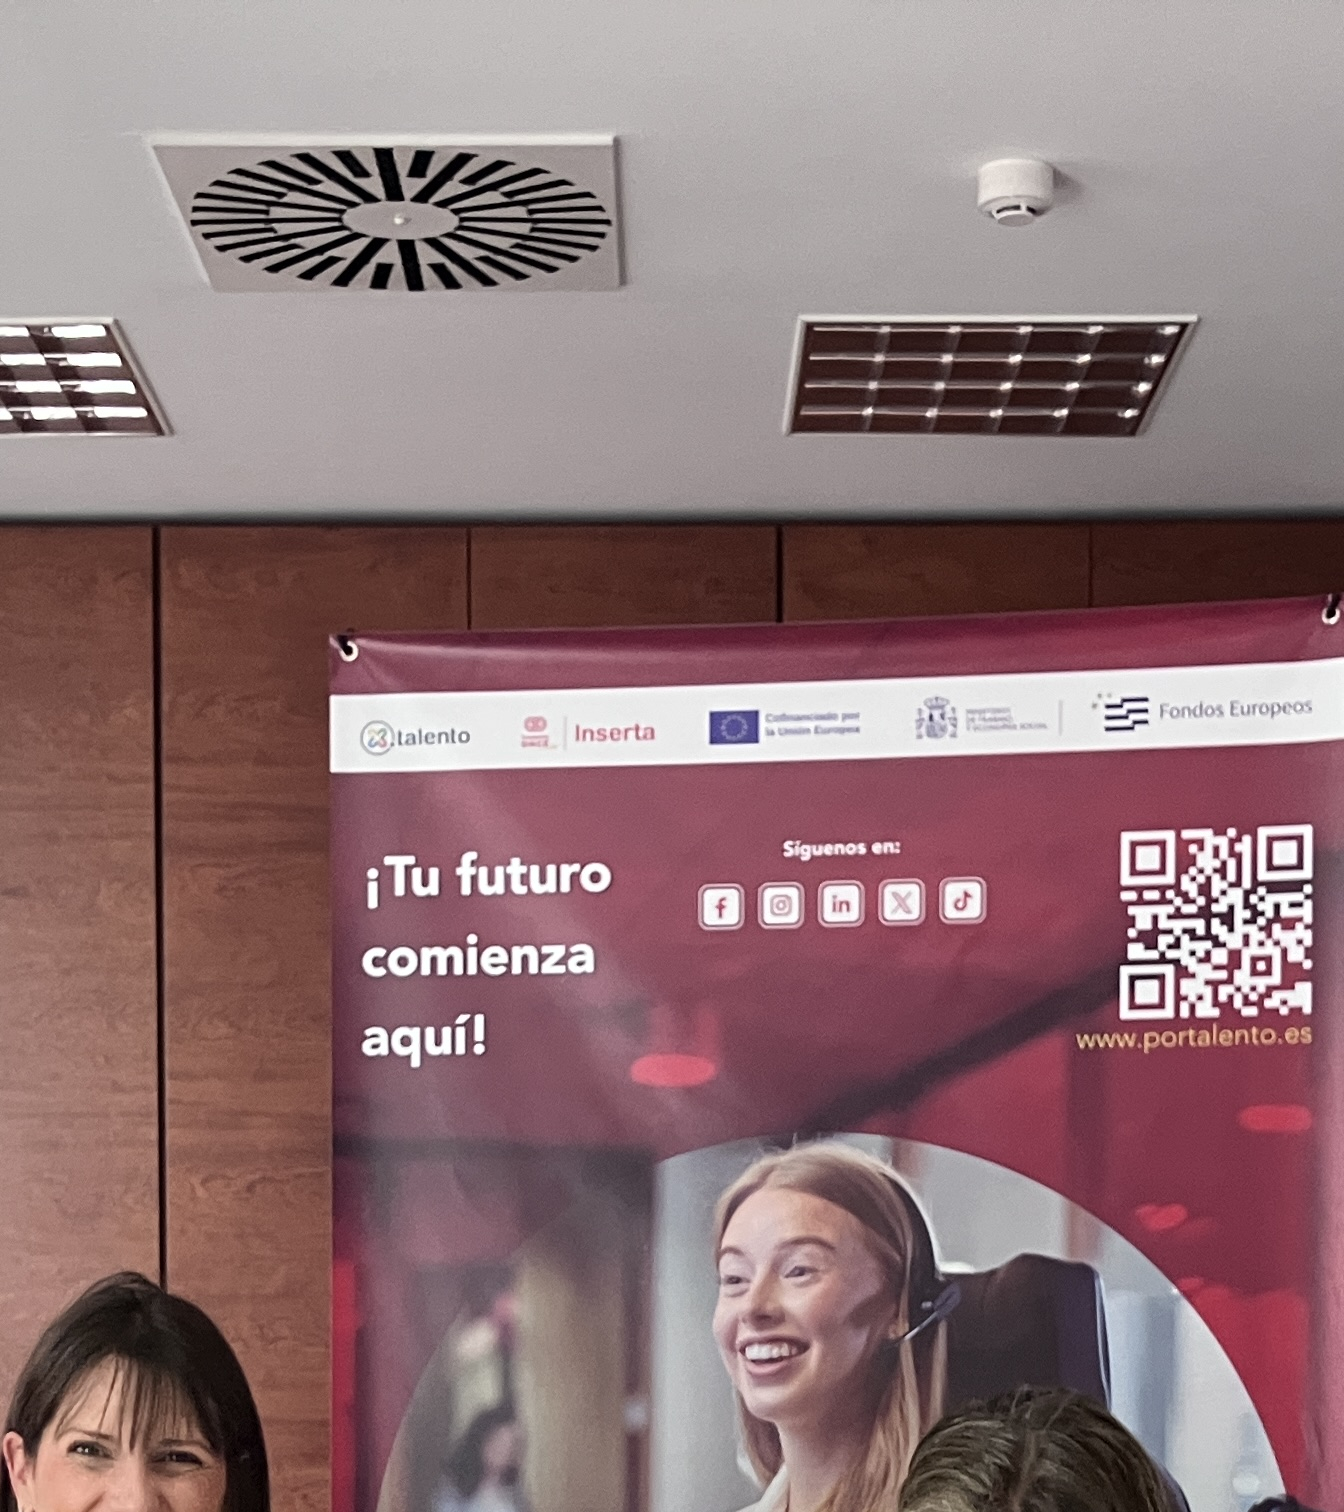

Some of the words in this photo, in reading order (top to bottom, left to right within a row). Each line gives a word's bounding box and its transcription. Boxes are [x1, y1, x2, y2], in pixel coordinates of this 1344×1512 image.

[1159, 702, 1225, 720] Fondos
[1229, 699, 1313, 719] Europeos
[575, 722, 657, 743] Inserta
[783, 840, 867, 861] Síguenos
[871, 840, 901, 854] en:
[366, 855, 440, 910] ¡Tu
[456, 851, 612, 897] futuro
[362, 933, 595, 978] comienza
[361, 1013, 486, 1068] aquí!
[1076, 1024, 1313, 1054] www.portalento.es
